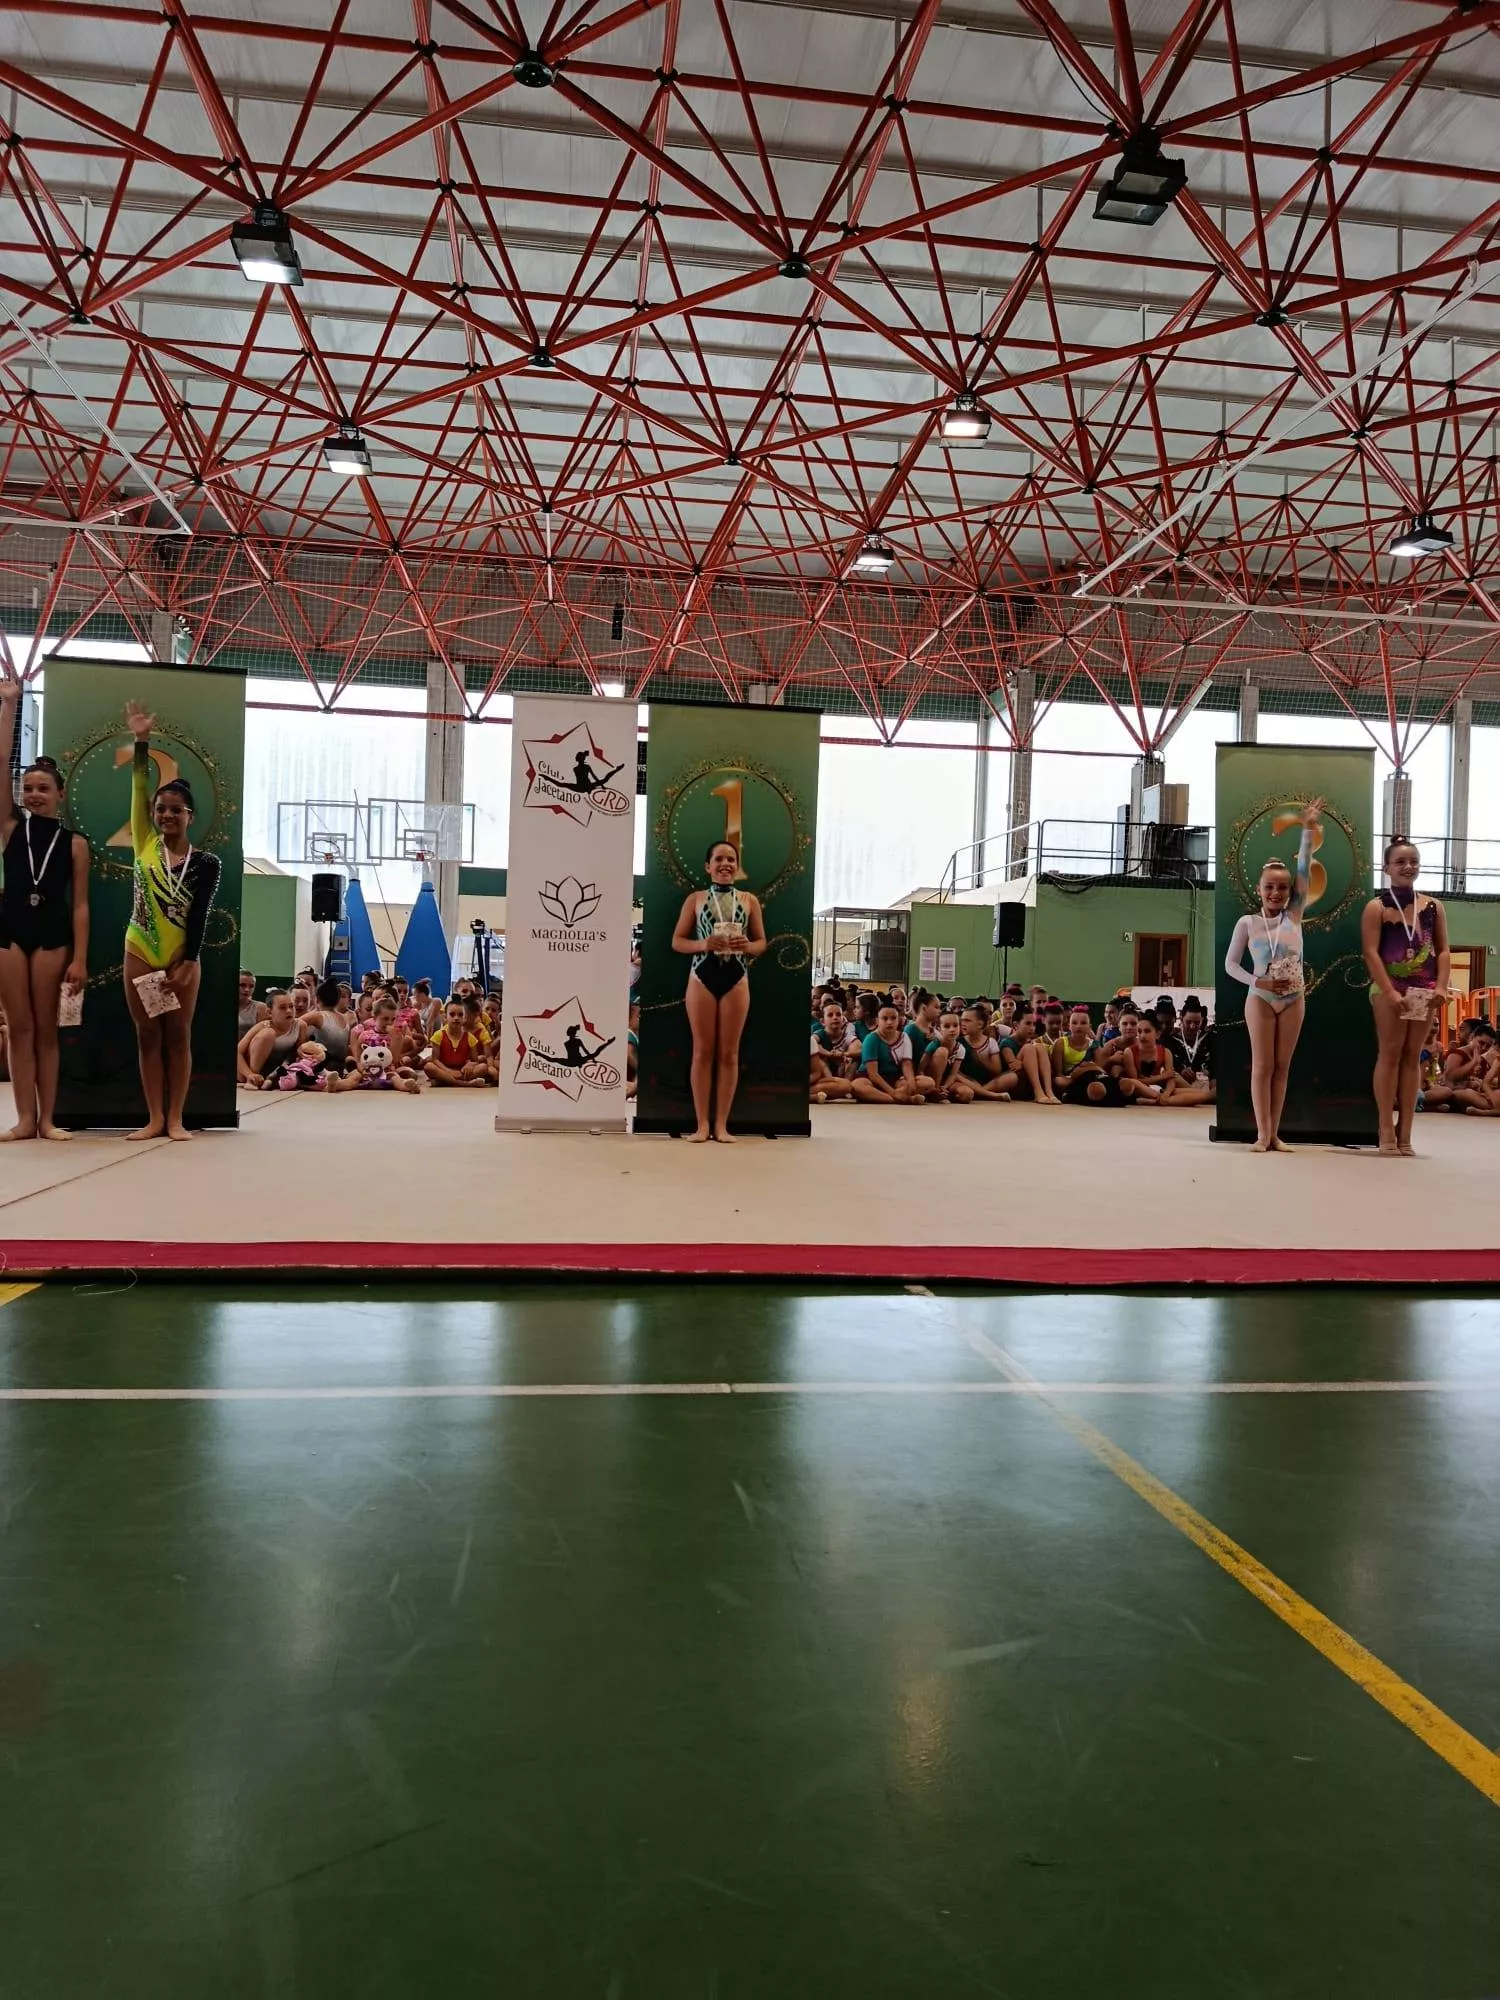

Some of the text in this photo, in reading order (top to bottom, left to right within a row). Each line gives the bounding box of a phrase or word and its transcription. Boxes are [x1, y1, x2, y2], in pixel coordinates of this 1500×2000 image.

[534, 778, 581, 803] Jacetano
[592, 789, 628, 810] GRD
[524, 1053, 572, 1078] Jacetano
[583, 1063, 619, 1084] GRD
